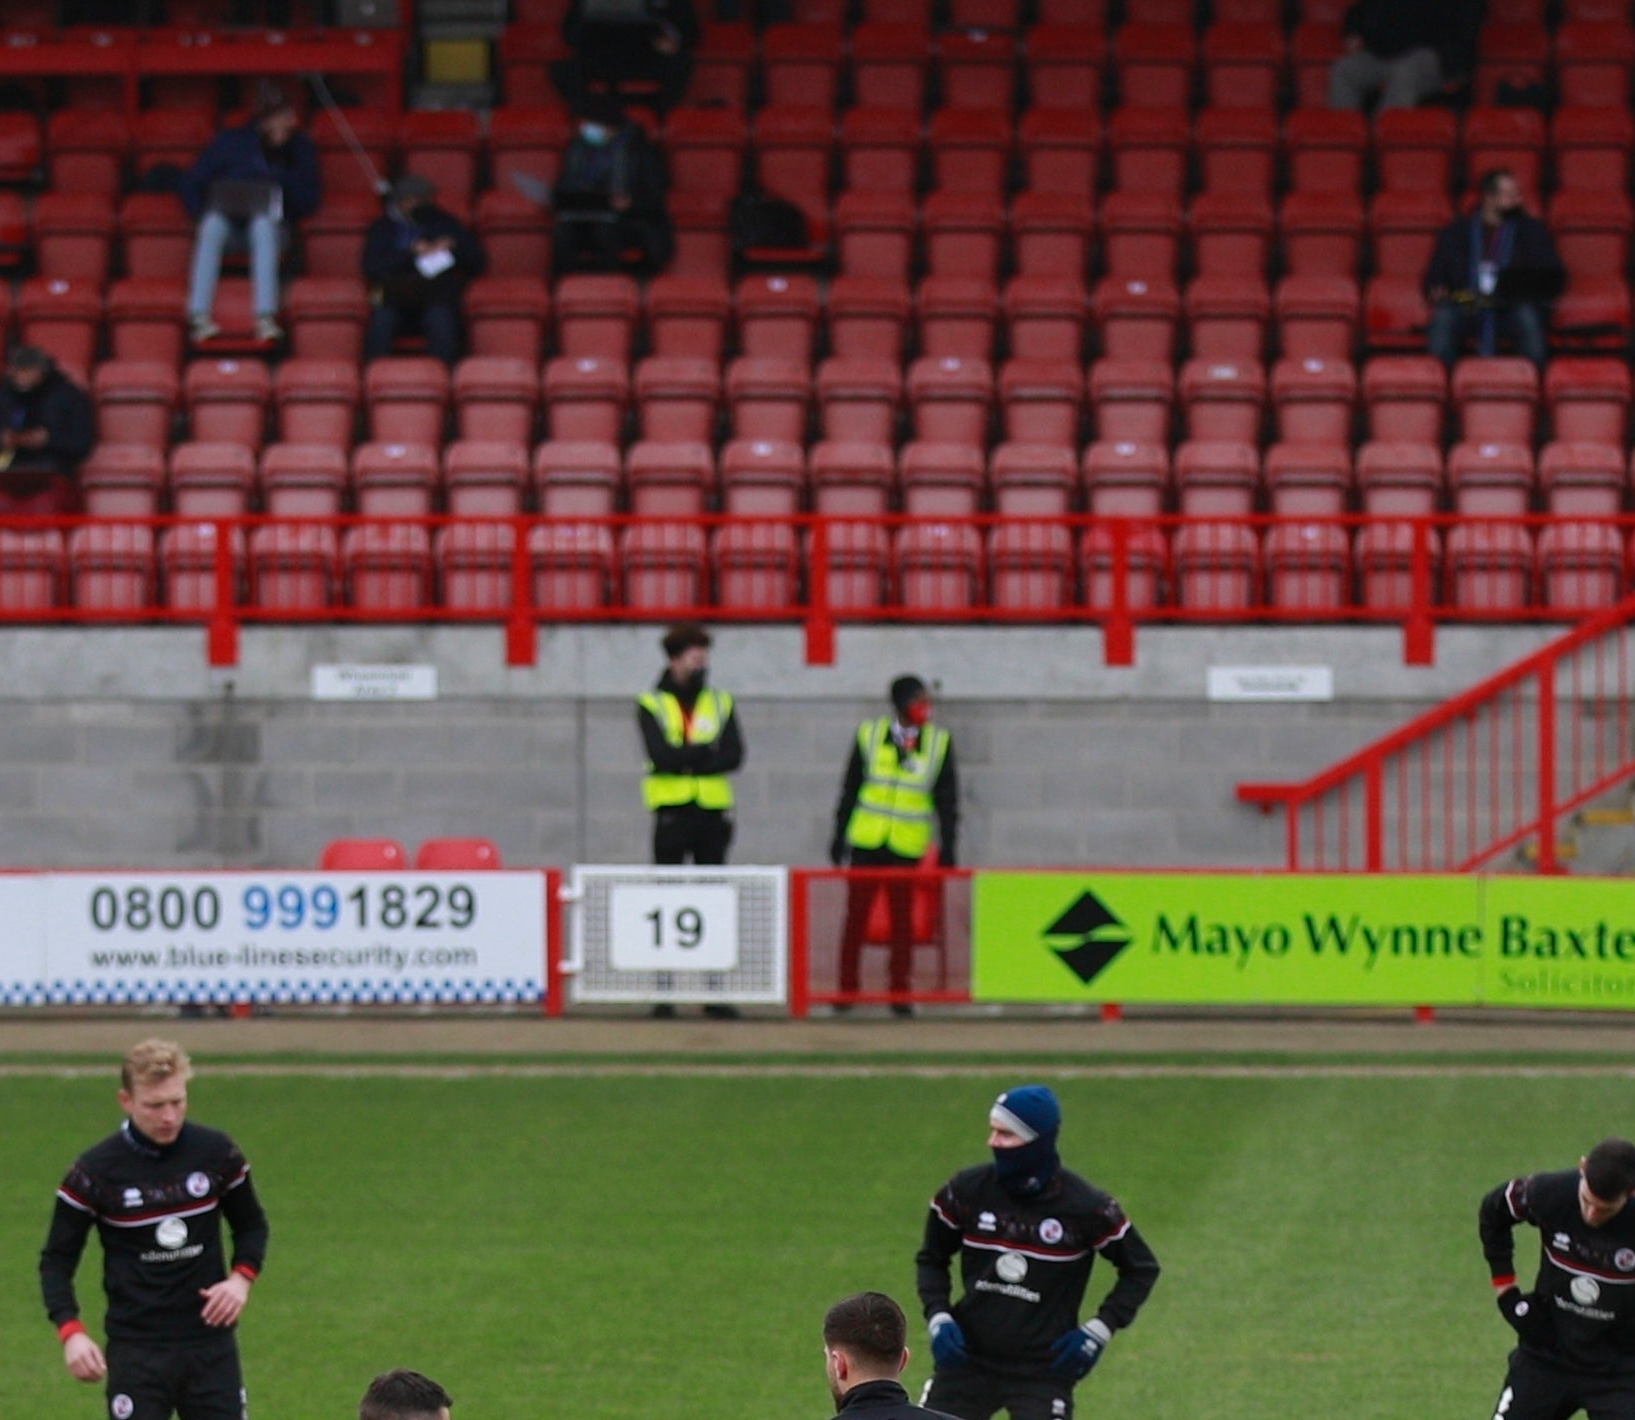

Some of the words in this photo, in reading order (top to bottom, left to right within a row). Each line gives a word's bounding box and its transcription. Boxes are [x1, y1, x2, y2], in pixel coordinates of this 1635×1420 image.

[90, 884, 222, 931] 0800
[242, 884, 477, 931] 9991829
[645, 906, 705, 949] 19
[90, 944, 478, 972] www.blue-linesecurity.com
[1151, 913, 1291, 969] Mayo
[1302, 913, 1483, 970] Wynne
